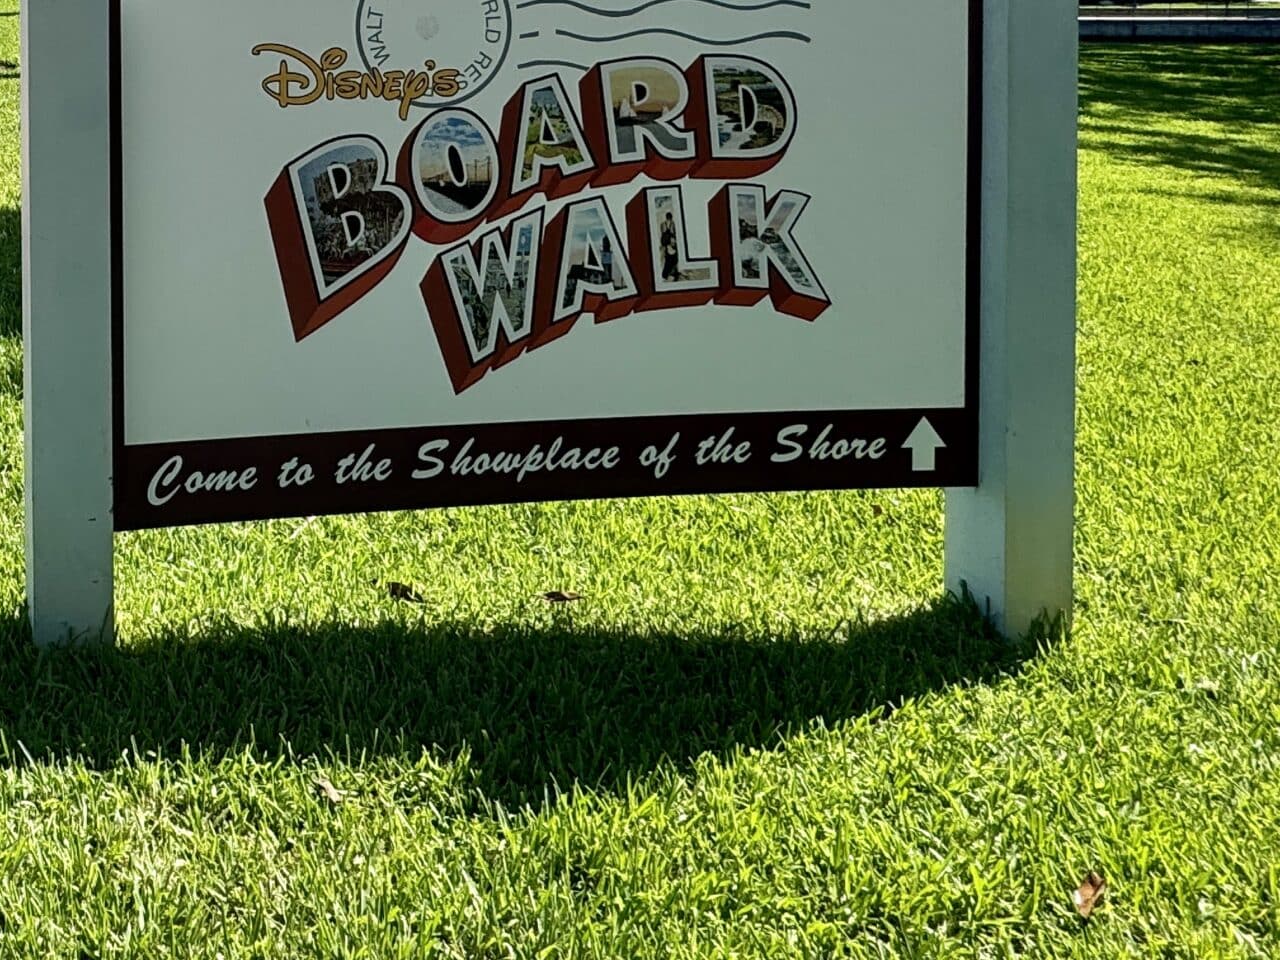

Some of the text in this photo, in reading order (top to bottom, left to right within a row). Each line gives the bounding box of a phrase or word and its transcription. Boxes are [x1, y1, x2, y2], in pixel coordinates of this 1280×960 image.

[366, 6, 391, 66] WALT
[264, 53, 798, 343] BOARD
[419, 183, 832, 395] WALK
[146, 423, 887, 506] Come to the Showplace of the Shore
